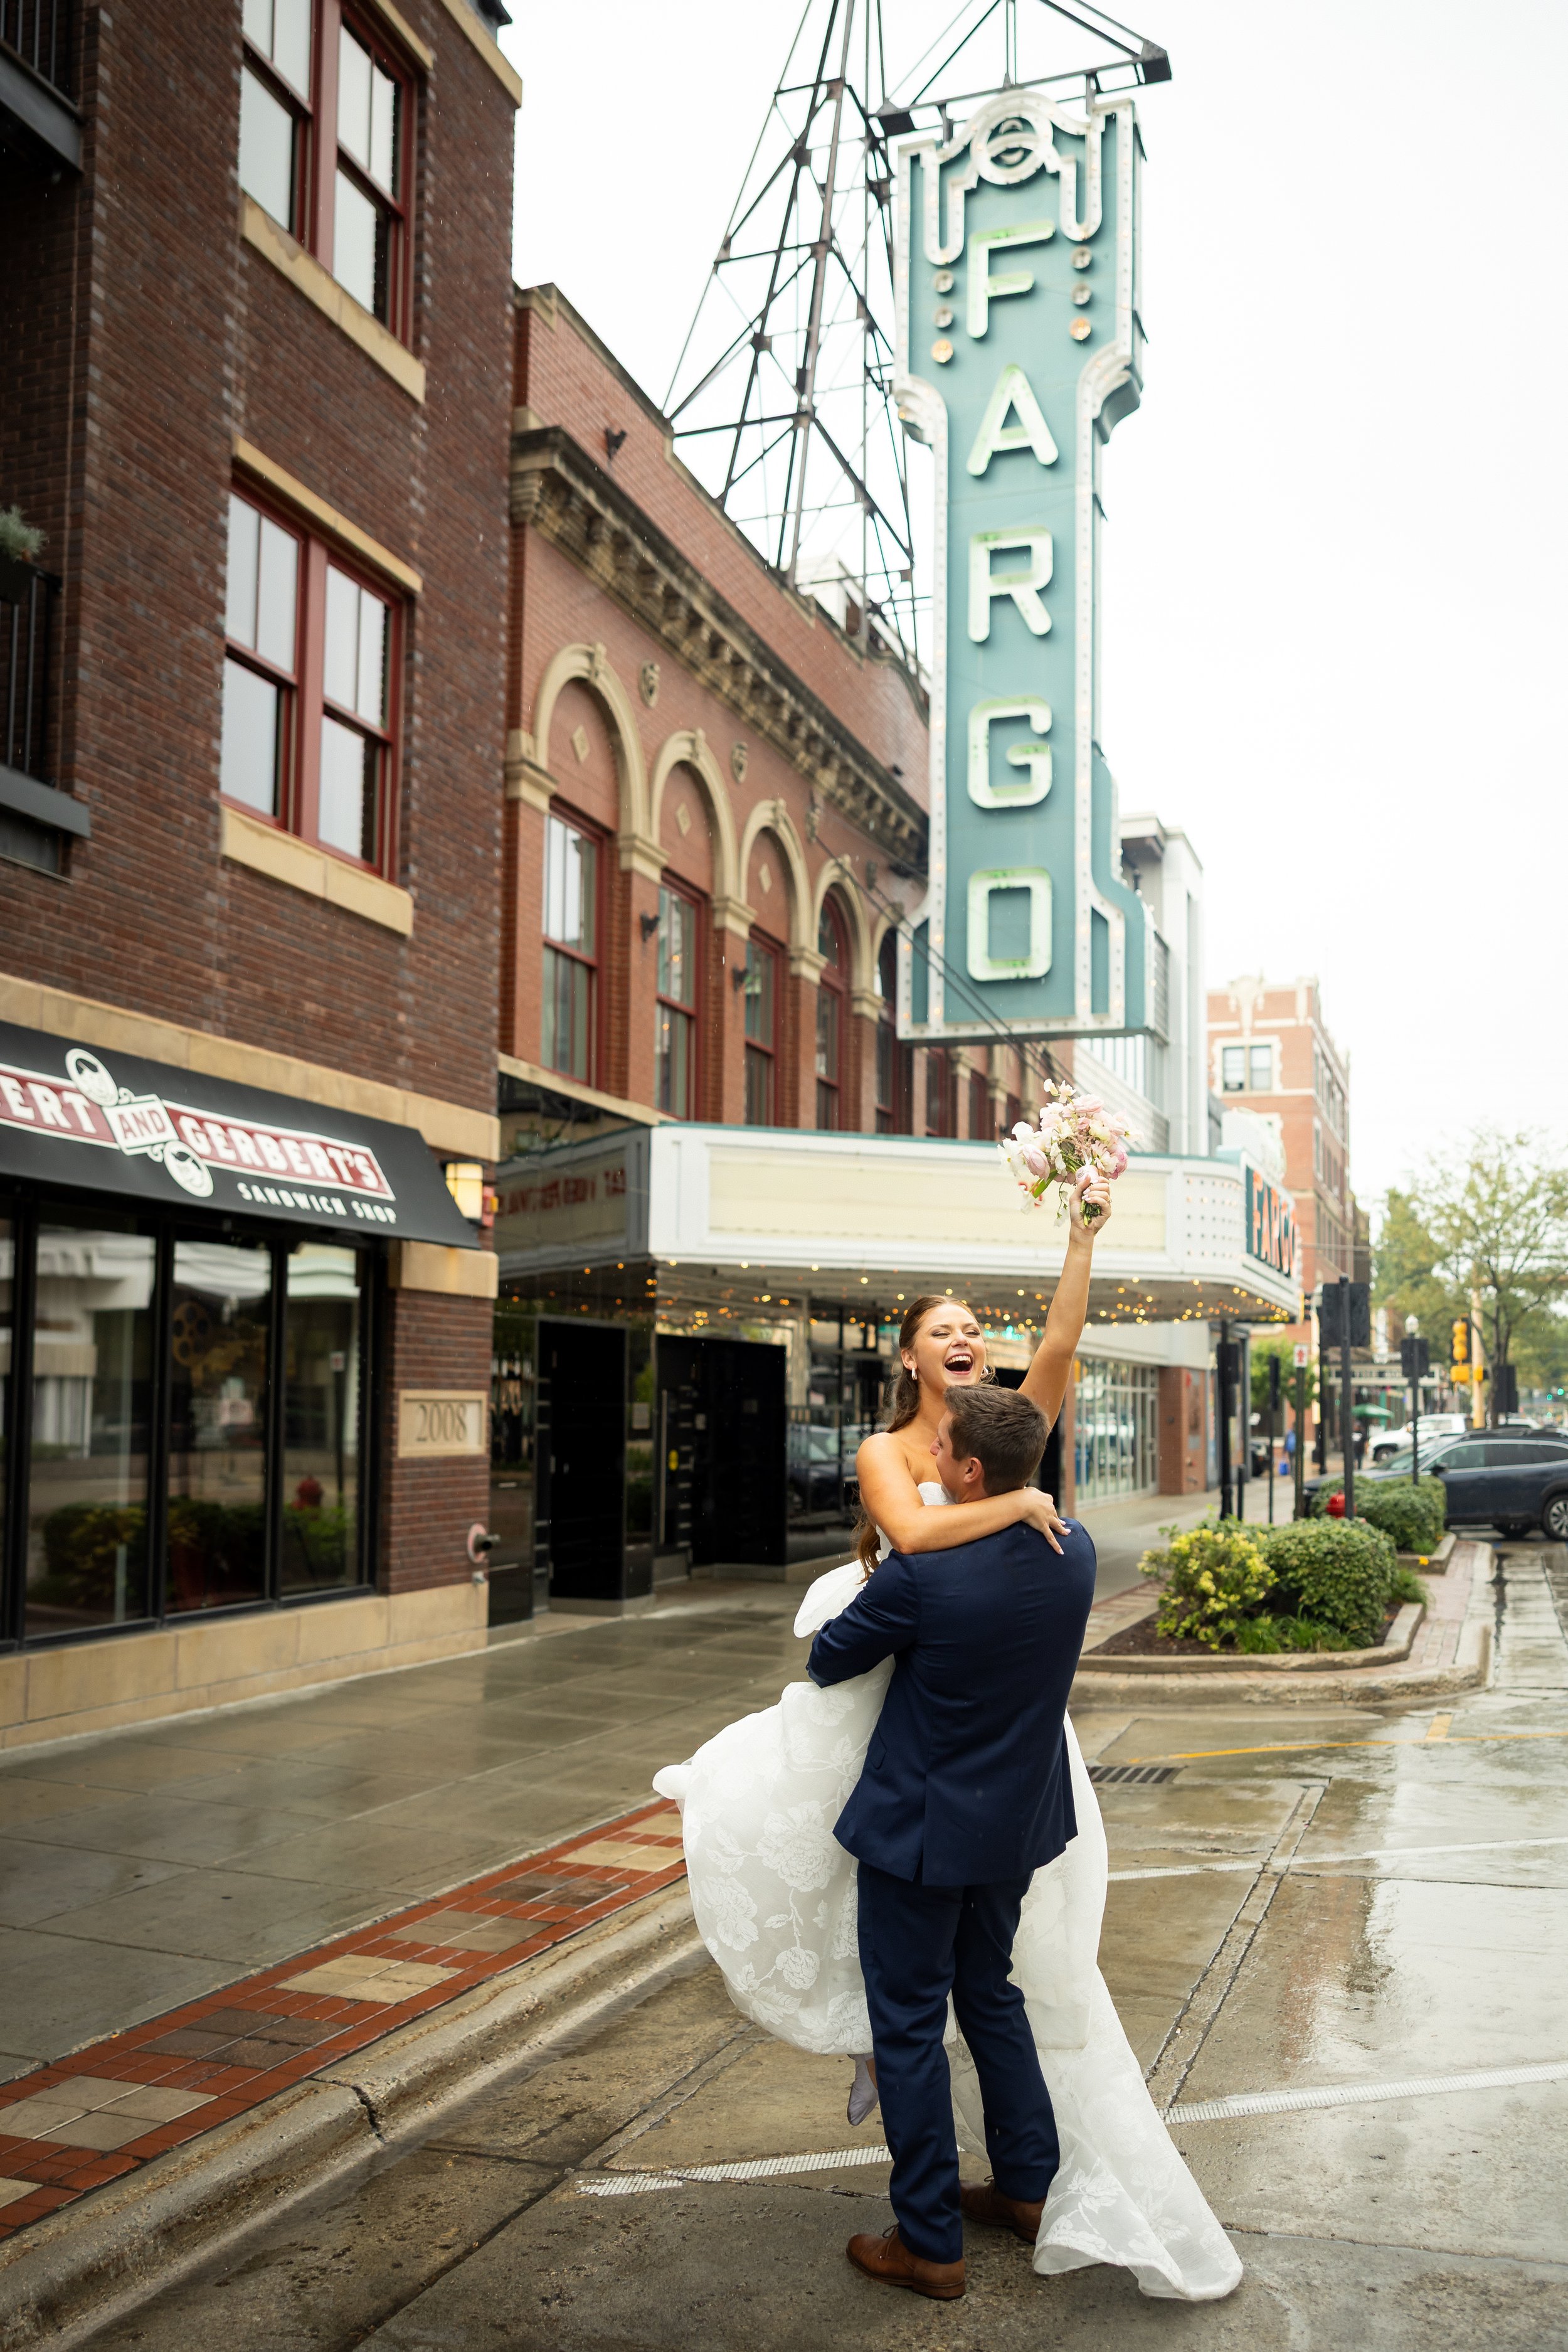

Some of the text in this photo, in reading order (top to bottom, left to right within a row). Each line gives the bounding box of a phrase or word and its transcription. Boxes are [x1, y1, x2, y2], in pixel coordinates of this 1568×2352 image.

[967, 221, 1058, 981] FARGO
[0, 1075, 379, 1188] ERT AND GERBERT'S
[236, 1181, 397, 1224] SANDWICH SHOP
[416, 1403, 467, 1442] 2008
